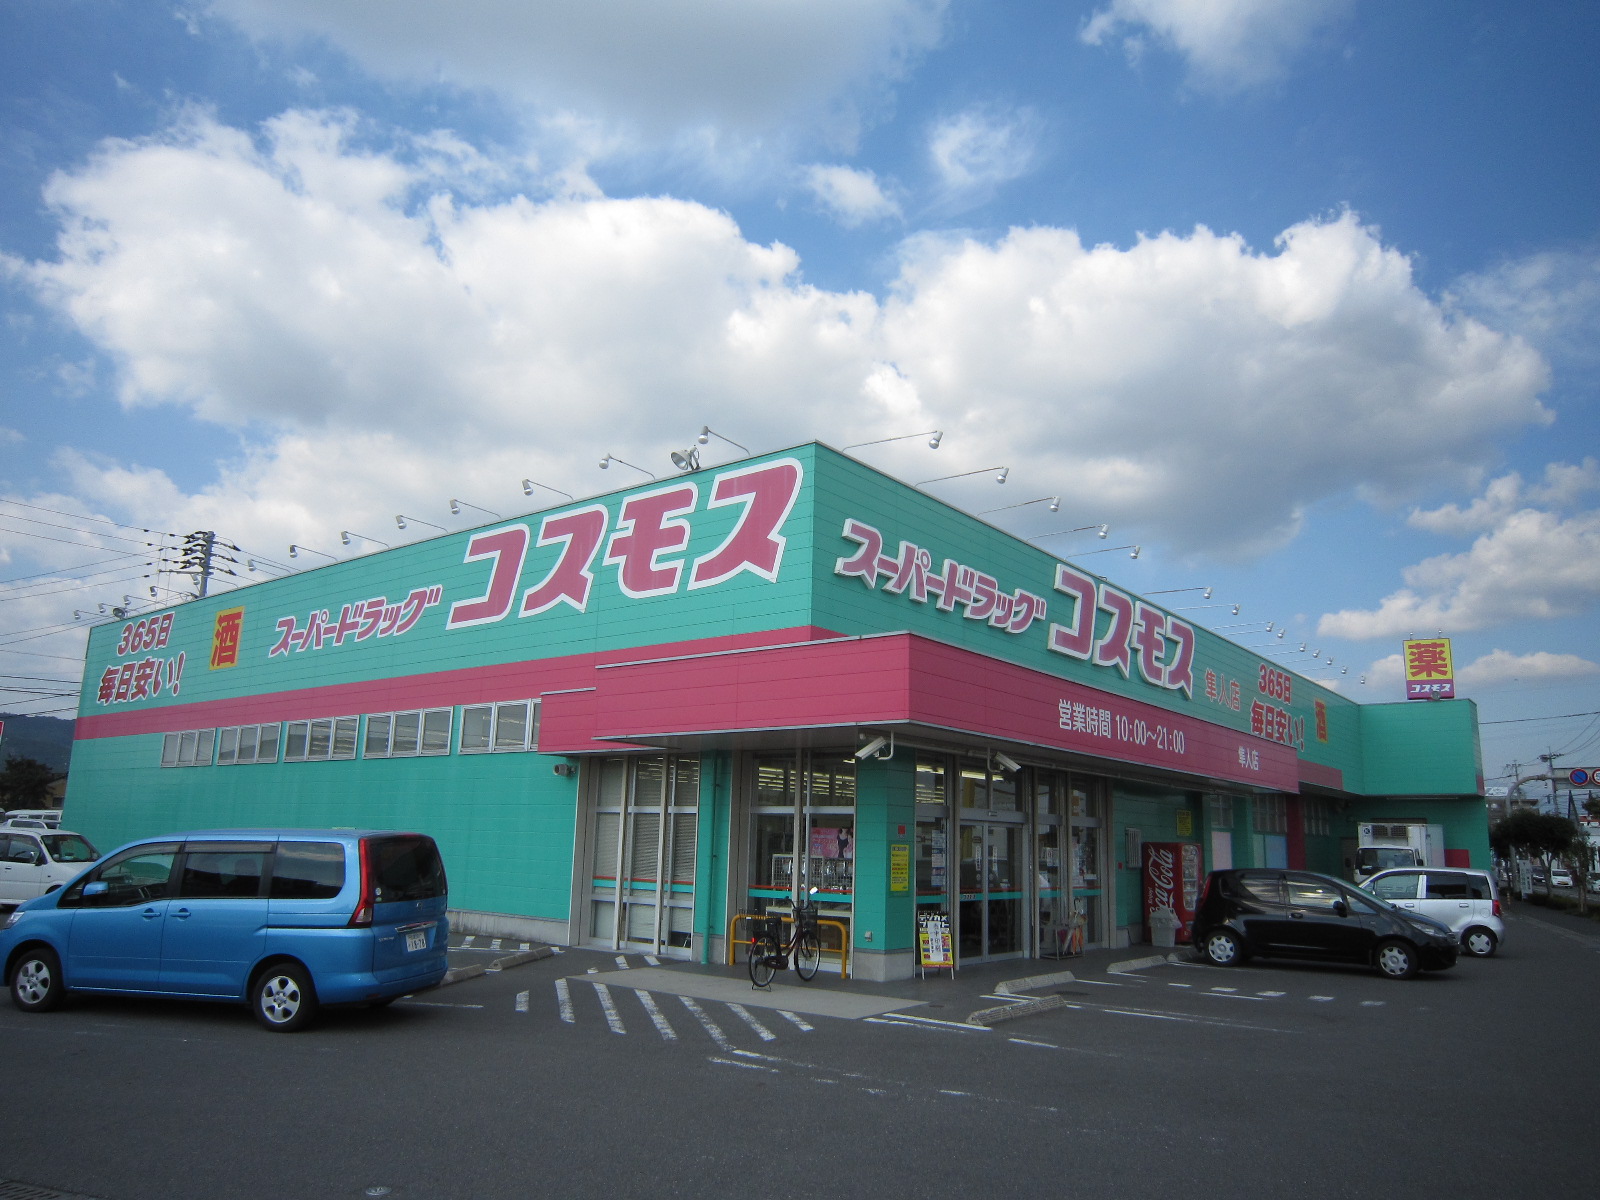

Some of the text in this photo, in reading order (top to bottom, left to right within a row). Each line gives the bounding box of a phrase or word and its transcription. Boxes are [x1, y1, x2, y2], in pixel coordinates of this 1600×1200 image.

[445, 457, 804, 630] コスモス
[834, 518, 1047, 634] スーパードラッグ
[116, 611, 176, 657] 365日
[211, 611, 244, 668] 酒
[268, 584, 443, 659] スーパードラッグ
[1047, 563, 1195, 700] コスモス
[97, 651, 187, 706] 毎日安い!
[1258, 663, 1291, 706] 365日
[1407, 642, 1449, 678] 薬
[1410, 683, 1451, 693] コスモス
[1058, 699, 1112, 740] 営業時間
[1250, 697, 1304, 752] 毎日安い!
